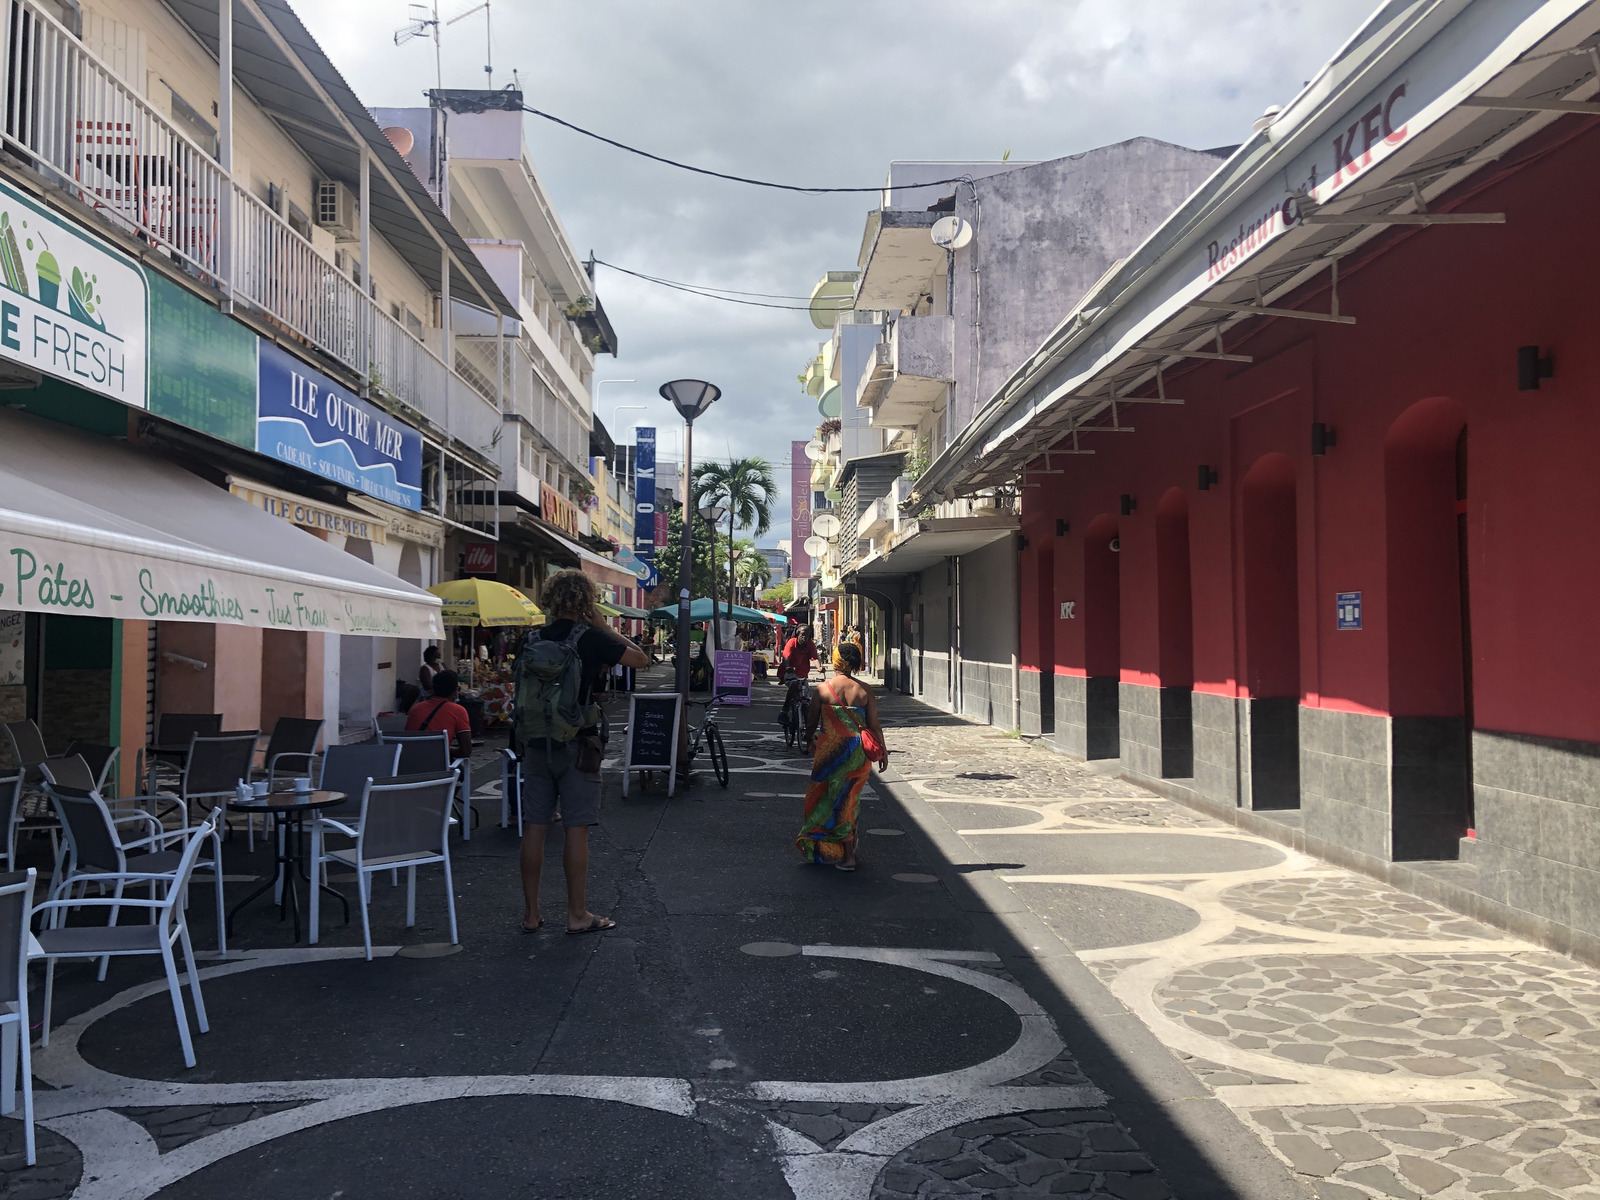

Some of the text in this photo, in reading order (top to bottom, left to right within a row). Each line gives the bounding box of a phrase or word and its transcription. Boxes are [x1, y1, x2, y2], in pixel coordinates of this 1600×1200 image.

[1332, 82, 1409, 190] KFC
[34, 315, 125, 392] FRESH
[290, 371, 403, 462] ILE OUTRE MER
[276, 441, 312, 469] CADEAUX
[318, 459, 356, 485] SOUVENIRS
[263, 497, 291, 519] ILE
[294, 506, 369, 537] OUTREMER
[467, 545, 493, 568] illy
[10, 548, 94, 609] Pâtes
[139, 569, 244, 621] Smoothies
[265, 588, 292, 625] Jus
[293, 592, 329, 630] Frais
[1060, 601, 1076, 619] KFC
